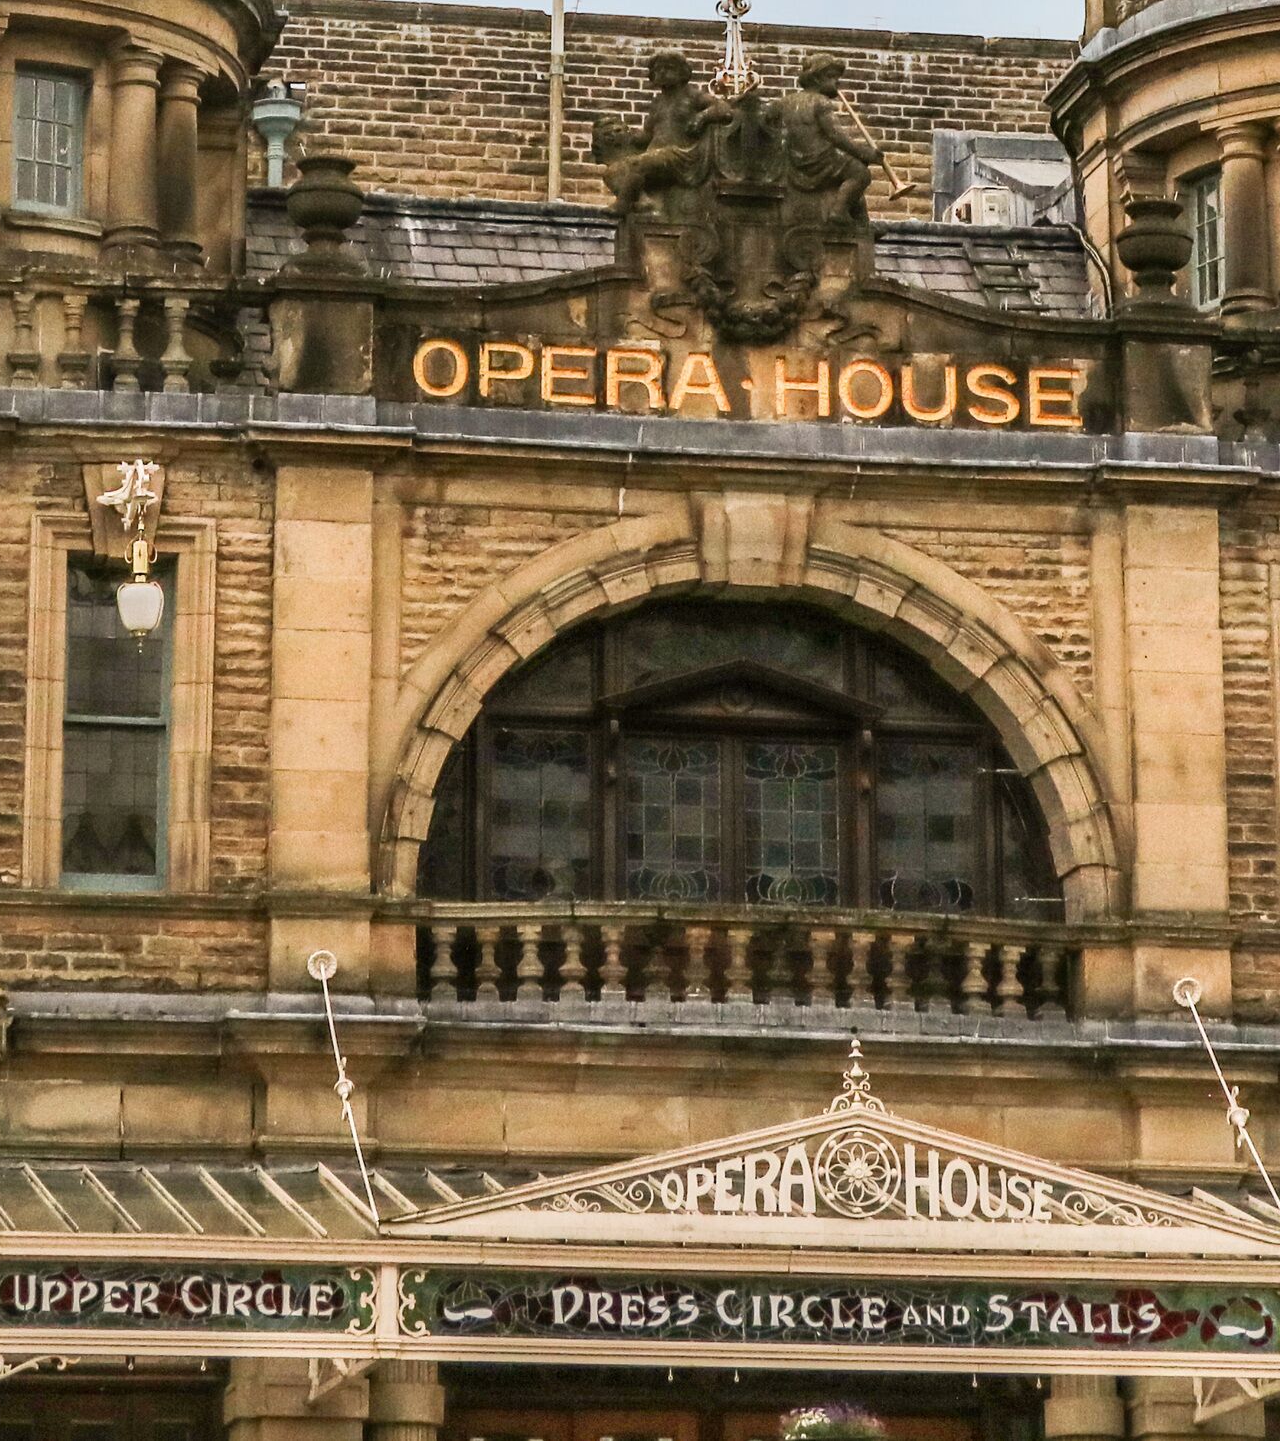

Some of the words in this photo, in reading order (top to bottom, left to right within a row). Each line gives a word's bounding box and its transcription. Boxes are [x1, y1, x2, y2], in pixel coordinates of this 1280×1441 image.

[412, 338, 732, 413] OPERA
[774, 355, 1084, 427] HOUSE
[660, 1141, 817, 1214] OPERA
[903, 1142, 1054, 1221] HOUSE
[13, 1274, 161, 1314] UPPER
[180, 1275, 334, 1317] CIRCLE
[552, 1285, 700, 1327] DRESS
[715, 1289, 887, 1330] CIRCLE
[902, 1304, 971, 1327] AND
[984, 1294, 1162, 1334] STALLS
